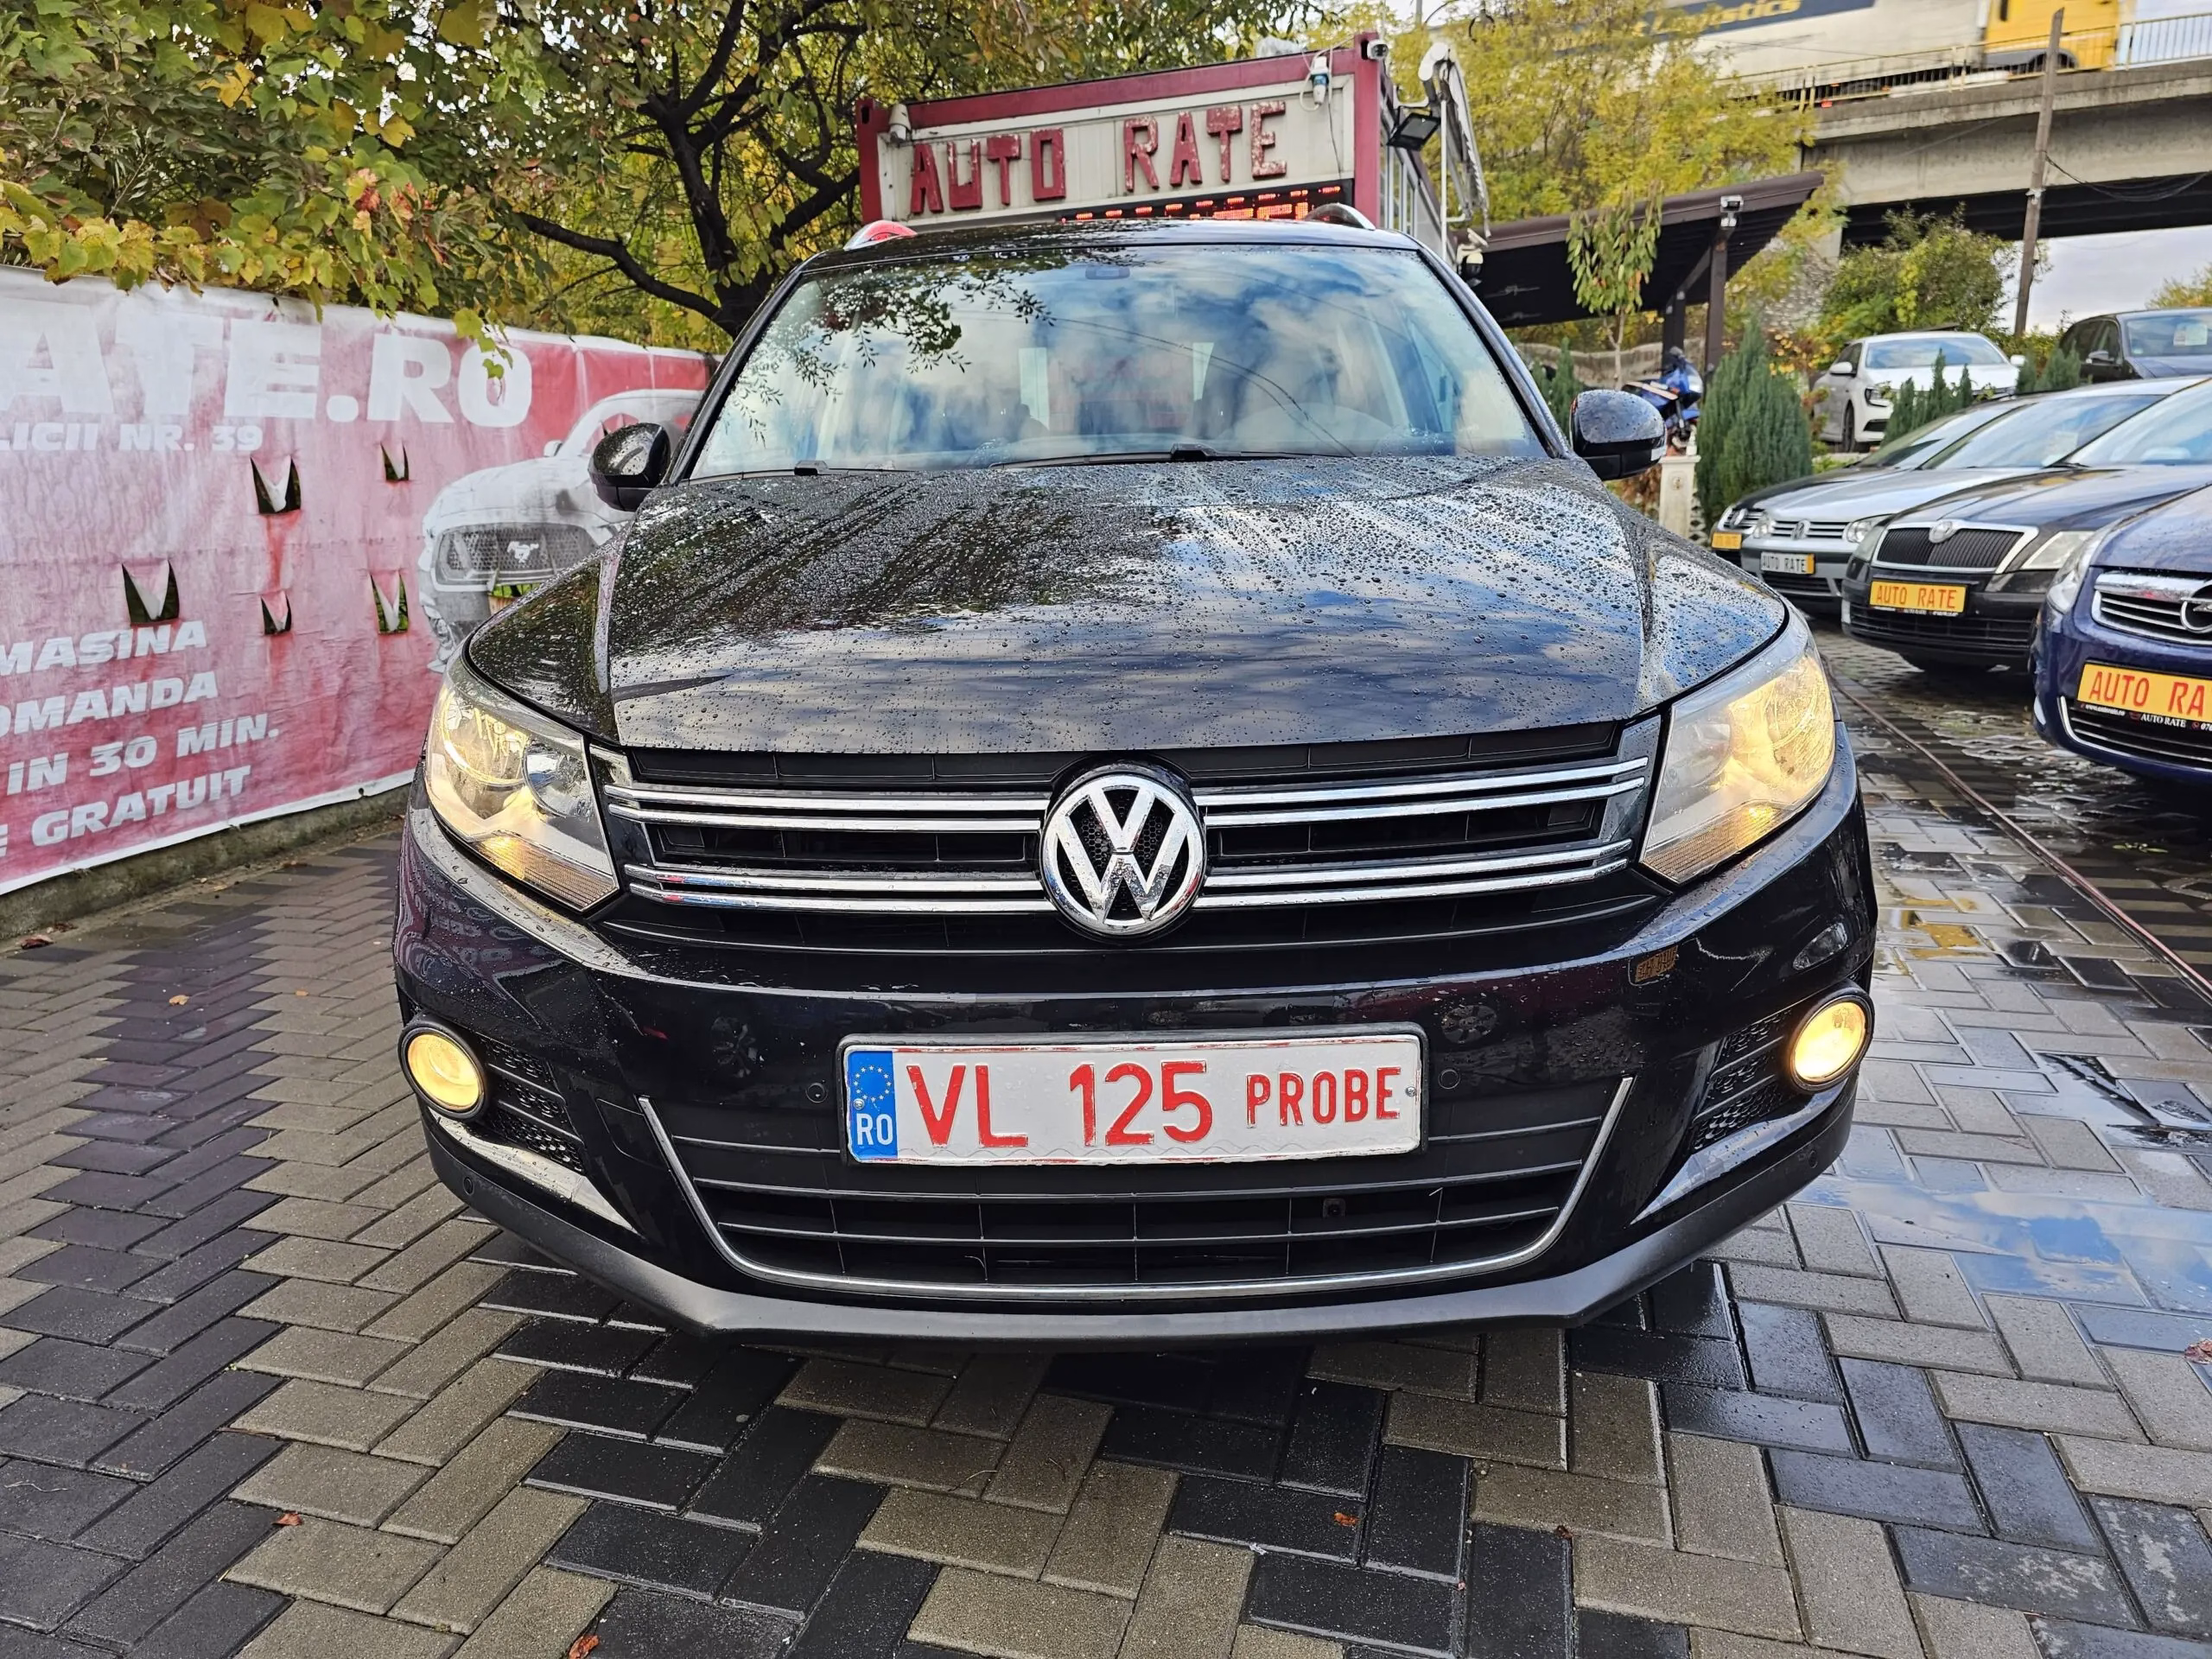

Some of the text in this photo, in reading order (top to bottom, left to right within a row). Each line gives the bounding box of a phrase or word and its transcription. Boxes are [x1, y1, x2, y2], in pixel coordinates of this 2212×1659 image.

[910, 127, 1067, 214] AUTO
[1123, 99, 1288, 192] RATE
[0, 301, 532, 428] ATE.RO
[118, 423, 195, 451] NR.
[211, 424, 264, 451] 39
[1876, 585, 1957, 609] AUTO RATE
[2088, 671, 2150, 708] AUTO
[2140, 713, 2164, 724] AUTO
[2164, 716, 2186, 728] RATE
[7, 714, 280, 795] IN 30 MIN.
[31, 765, 251, 847] GRATUIT
[855, 1113, 894, 1147] RO
[906, 1060, 1402, 1148] VL 125 PROBE
